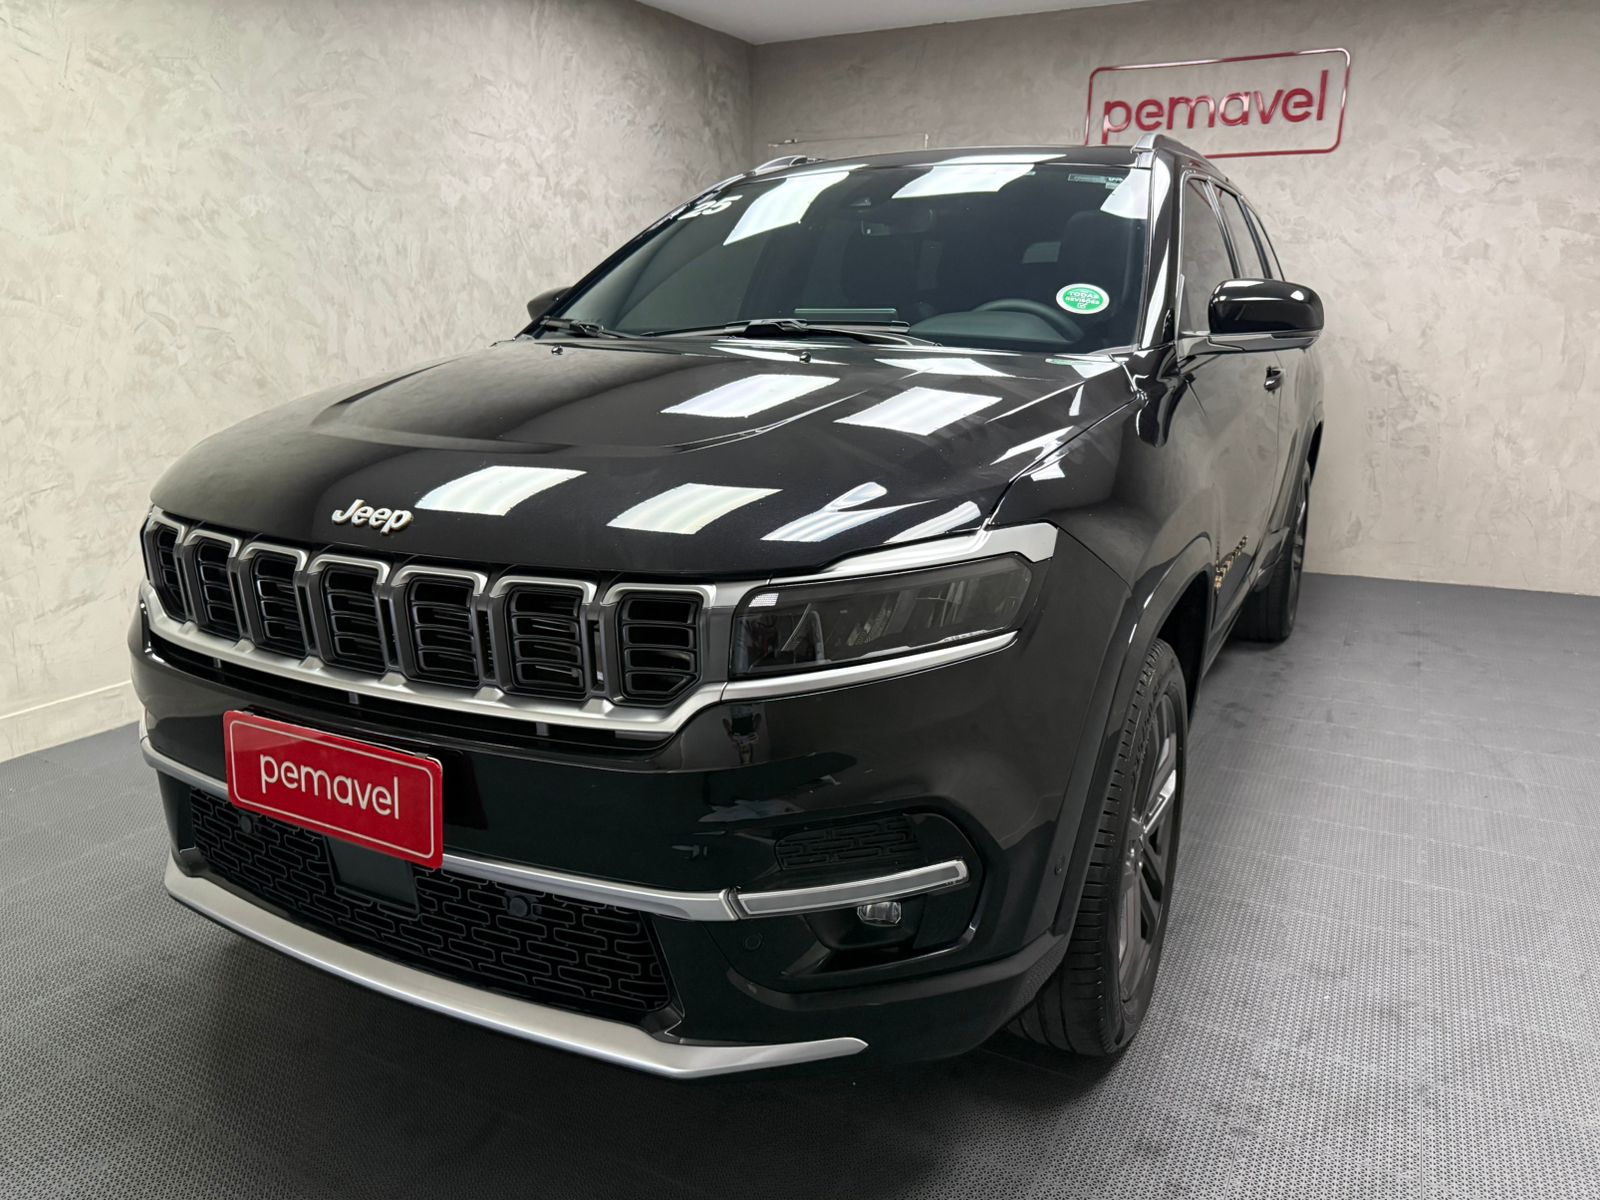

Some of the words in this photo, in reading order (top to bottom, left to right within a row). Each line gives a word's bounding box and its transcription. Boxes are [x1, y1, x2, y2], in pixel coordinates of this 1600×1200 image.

[1101, 69, 1329, 145] pemavel
[677, 194, 744, 221] 25
[331, 498, 413, 535] Jeep
[259, 753, 400, 820] pemavel
